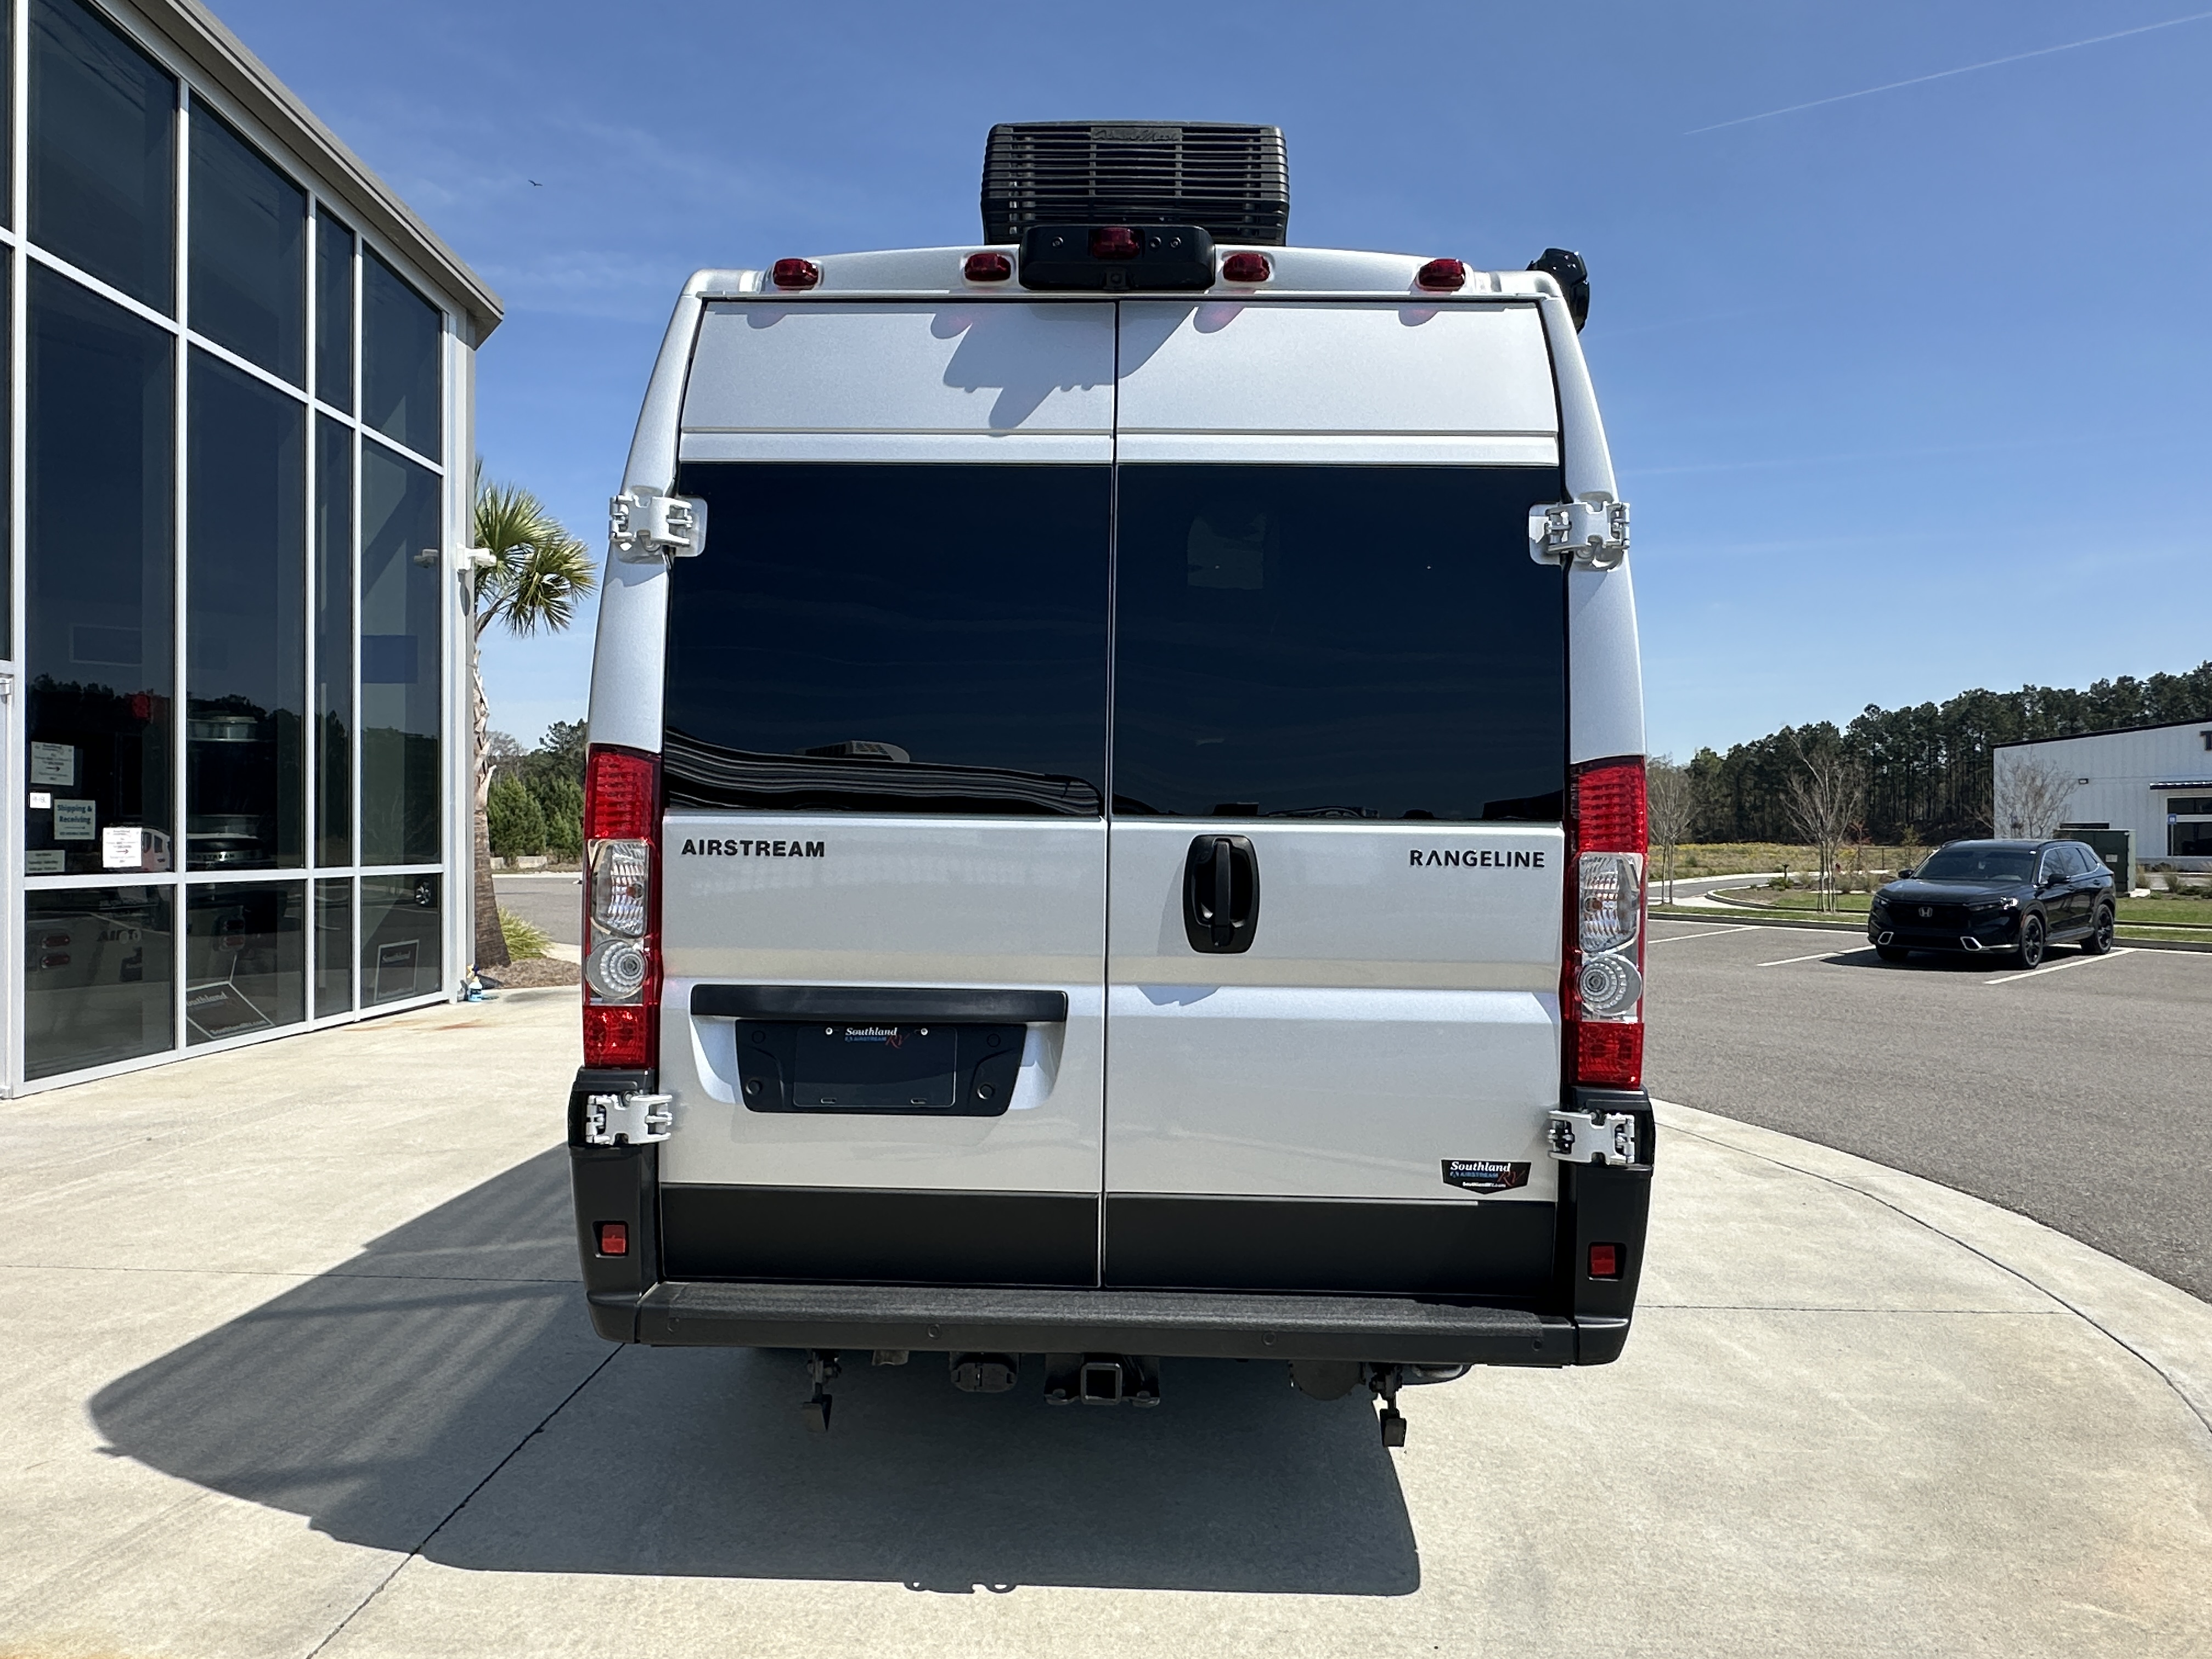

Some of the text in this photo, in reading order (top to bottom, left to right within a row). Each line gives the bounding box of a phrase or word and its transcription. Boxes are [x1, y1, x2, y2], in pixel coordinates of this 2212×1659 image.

[58, 804, 86, 814] Shipping
[59, 816, 91, 825] Receiving
[681, 839, 825, 857] AIRSTREAM
[1410, 850, 1545, 867] RANGELINE
[187, 992, 228, 1005] outhland
[845, 1027, 898, 1036] Southland
[1449, 1161, 1511, 1172] Southland
